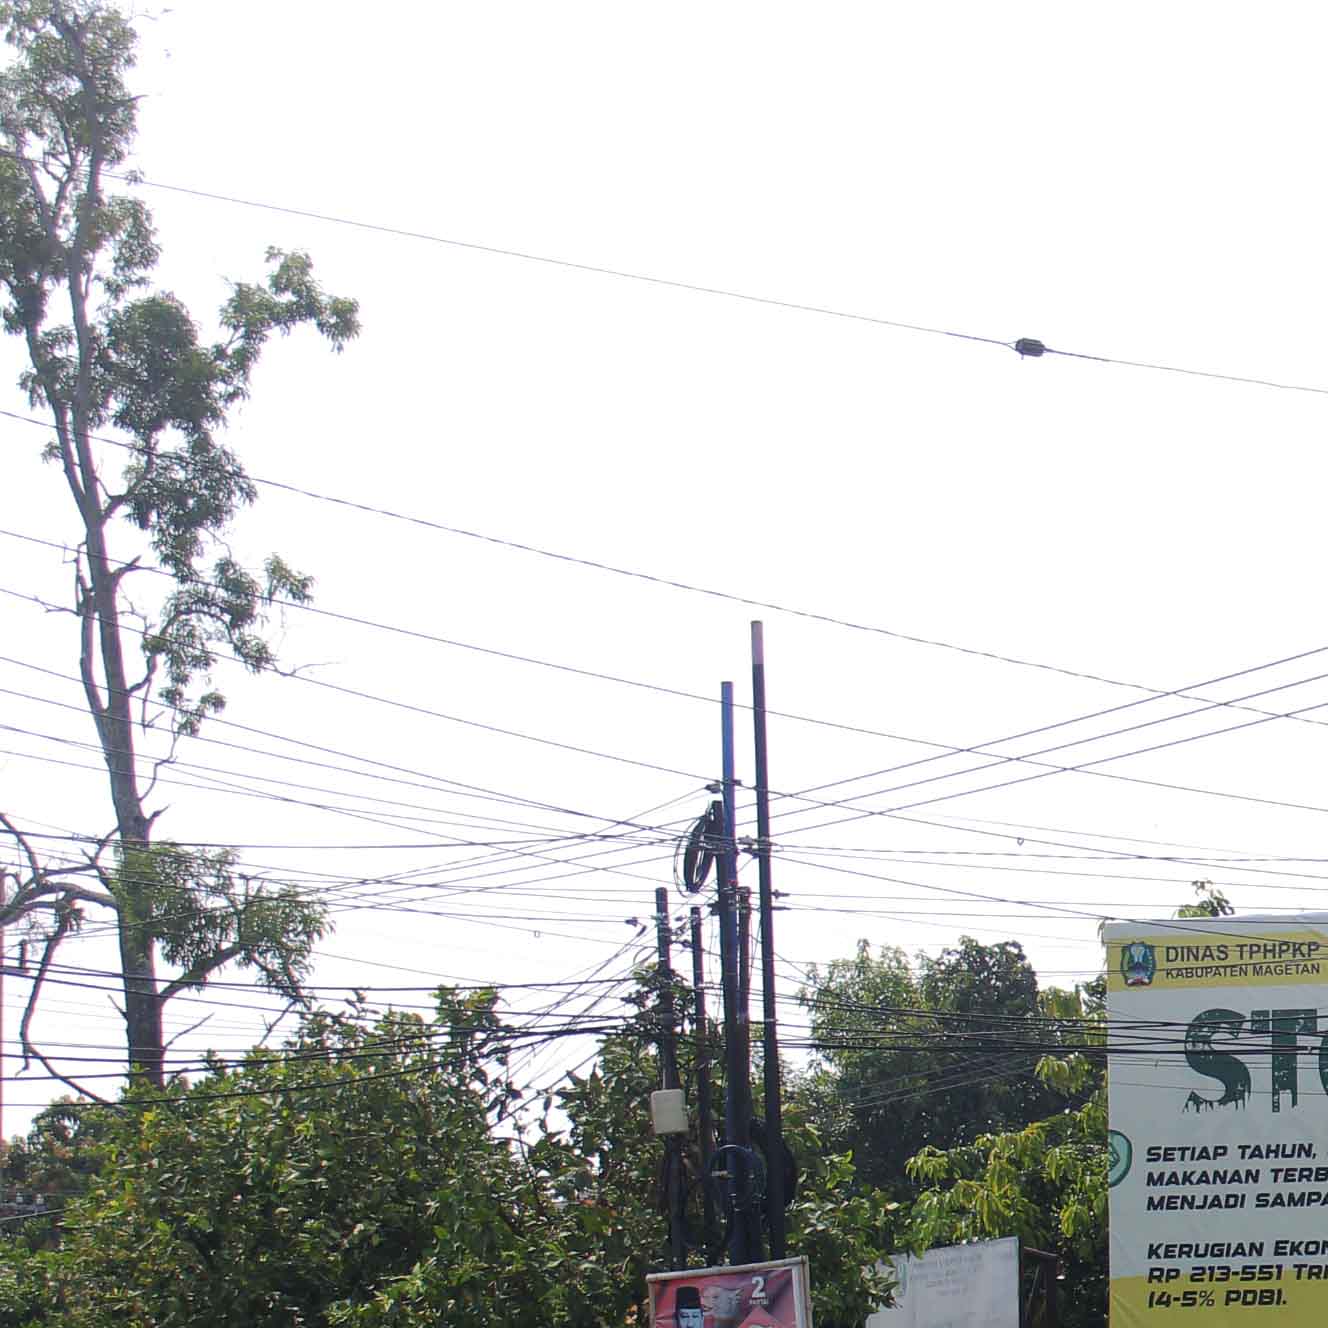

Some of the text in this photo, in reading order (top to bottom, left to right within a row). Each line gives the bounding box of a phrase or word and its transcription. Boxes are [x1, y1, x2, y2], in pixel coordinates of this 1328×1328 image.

[1165, 940, 1321, 963] DINAS TPHPKP
[1165, 962, 1321, 979] KABUPATEN MAGETAN
[1146, 1144, 1228, 1162] SETIAP
[1238, 1142, 1317, 1160] TAHUN,
[1146, 1168, 1260, 1186] MAKANAN
[1146, 1193, 1246, 1211] MENJADI
[1147, 1241, 1264, 1259] KERUGIAN
[1147, 1267, 1180, 1284] RP
[1189, 1264, 1283, 1282] 213-551
[752, 1276, 766, 1298] 2
